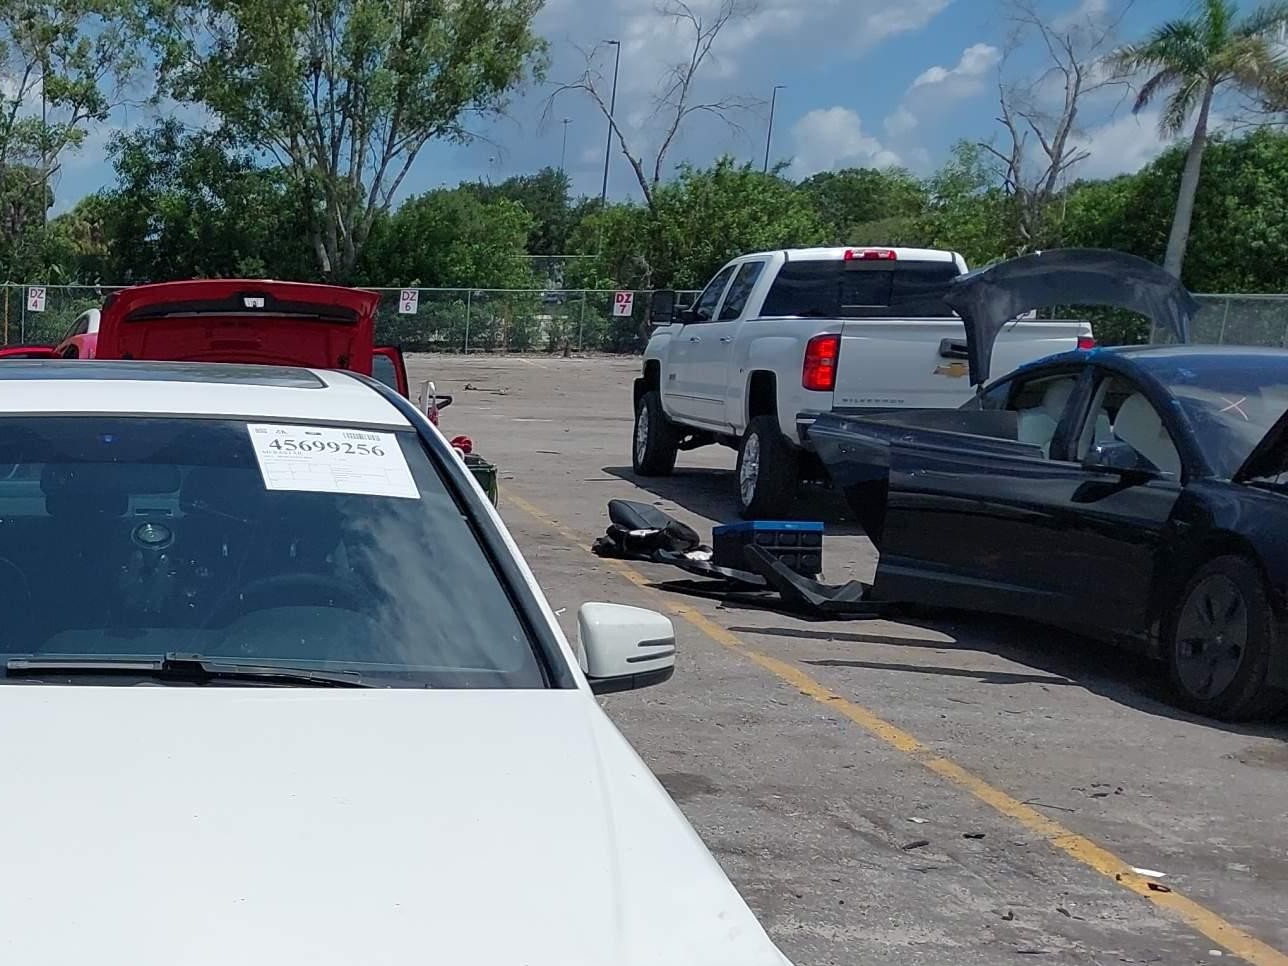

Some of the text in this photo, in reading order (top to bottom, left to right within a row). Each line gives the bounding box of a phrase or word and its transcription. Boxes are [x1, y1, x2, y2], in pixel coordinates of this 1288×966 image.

[30, 289, 44, 299] DZ
[402, 291, 416, 301] DZ
[616, 294, 632, 303] DZ
[32, 299, 38, 309] 4
[405, 302, 411, 311] 6
[619, 304, 627, 313] 7
[269, 438, 385, 457] 45699256
